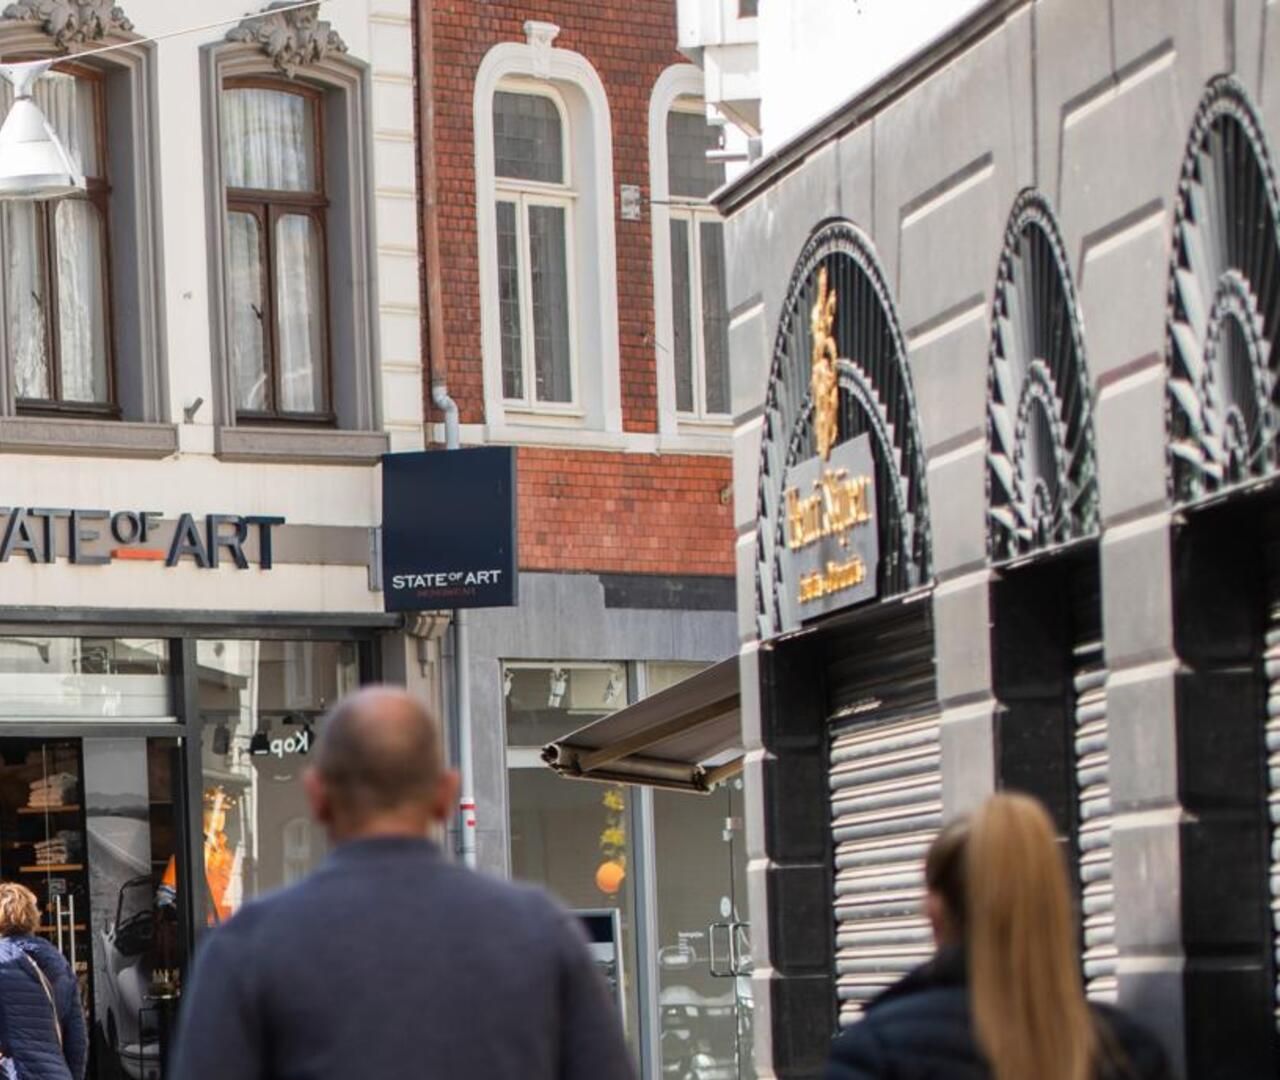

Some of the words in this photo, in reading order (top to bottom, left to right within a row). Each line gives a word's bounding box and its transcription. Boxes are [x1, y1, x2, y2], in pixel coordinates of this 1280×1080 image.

[111, 510, 163, 544] OF
[165, 512, 285, 570] ART
[392, 573, 448, 589] STATE
[448, 572, 464, 581] OF
[465, 569, 502, 585] ART
